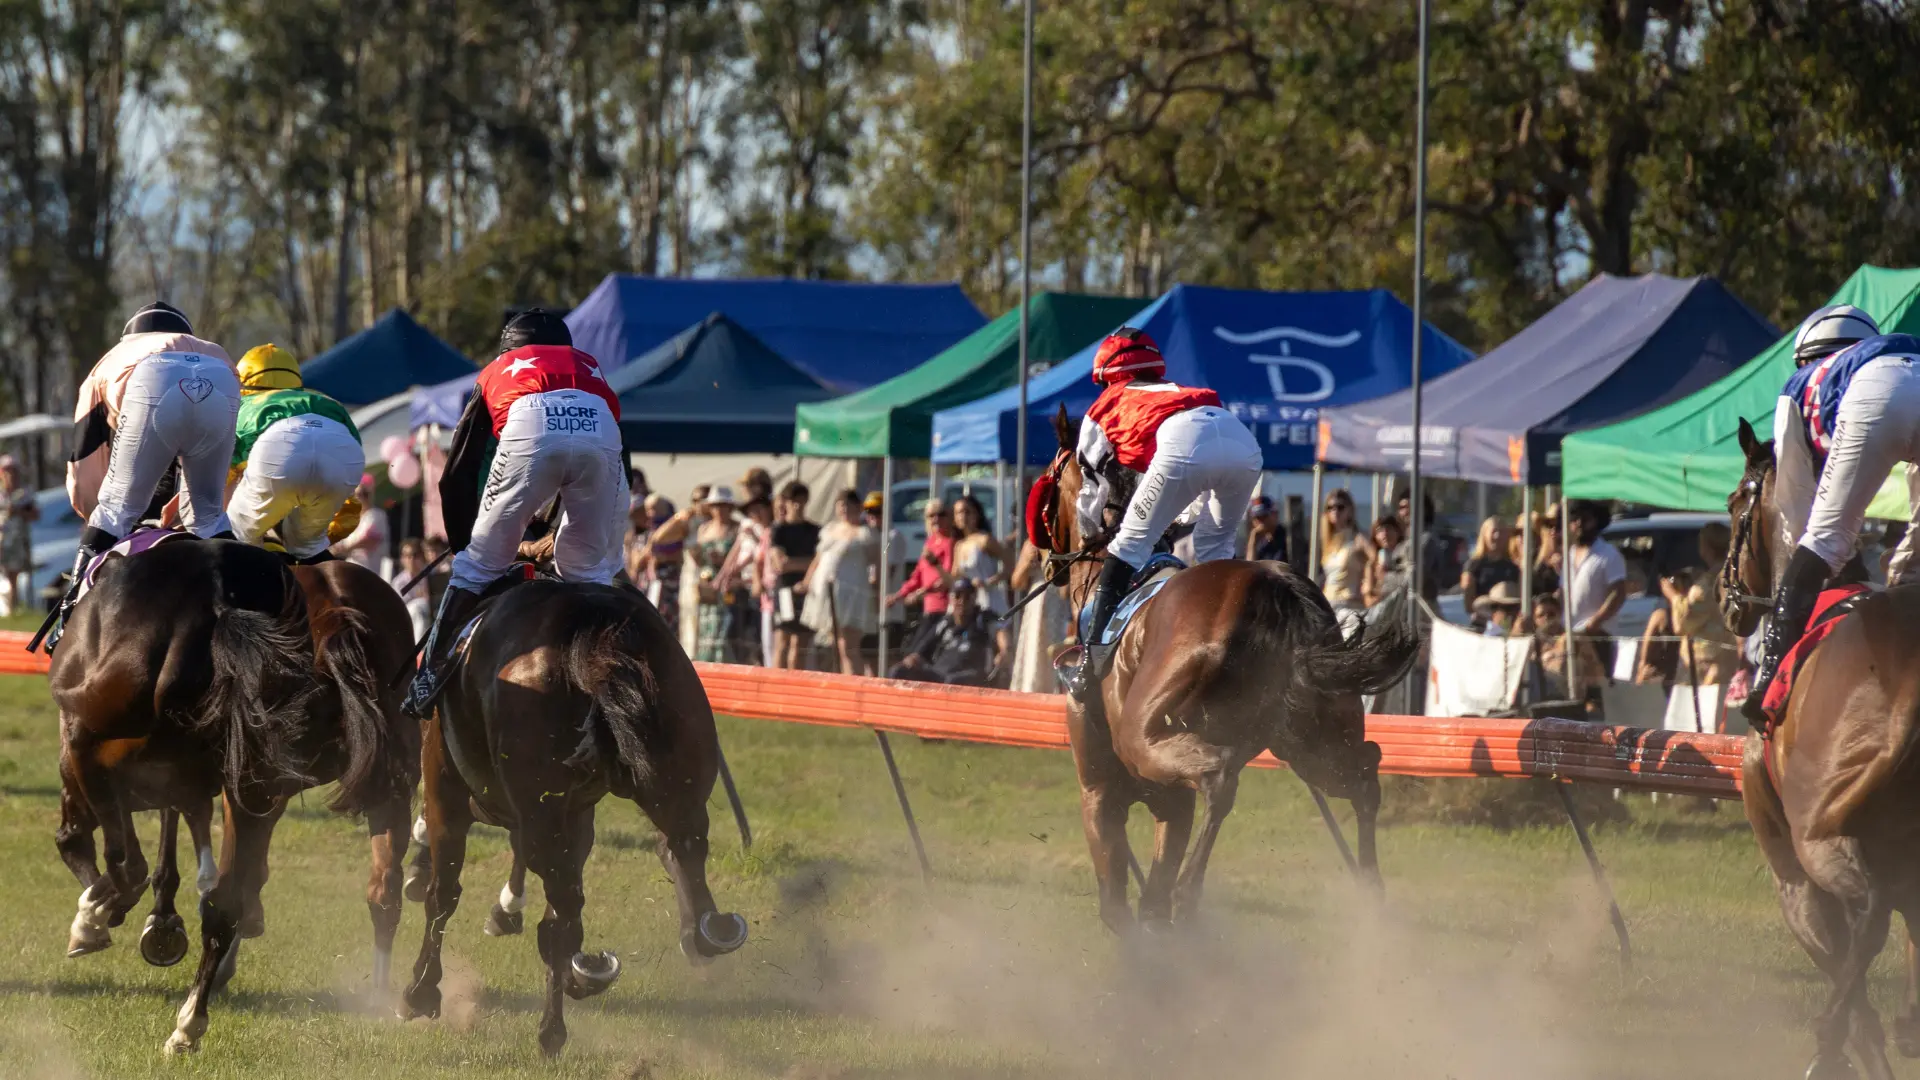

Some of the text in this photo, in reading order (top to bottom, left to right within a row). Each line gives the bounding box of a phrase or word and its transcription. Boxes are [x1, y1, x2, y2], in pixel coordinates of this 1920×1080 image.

[545, 406, 598, 419] LUCRF
[547, 418, 599, 434] super
[1141, 473, 1165, 511] BOYD
